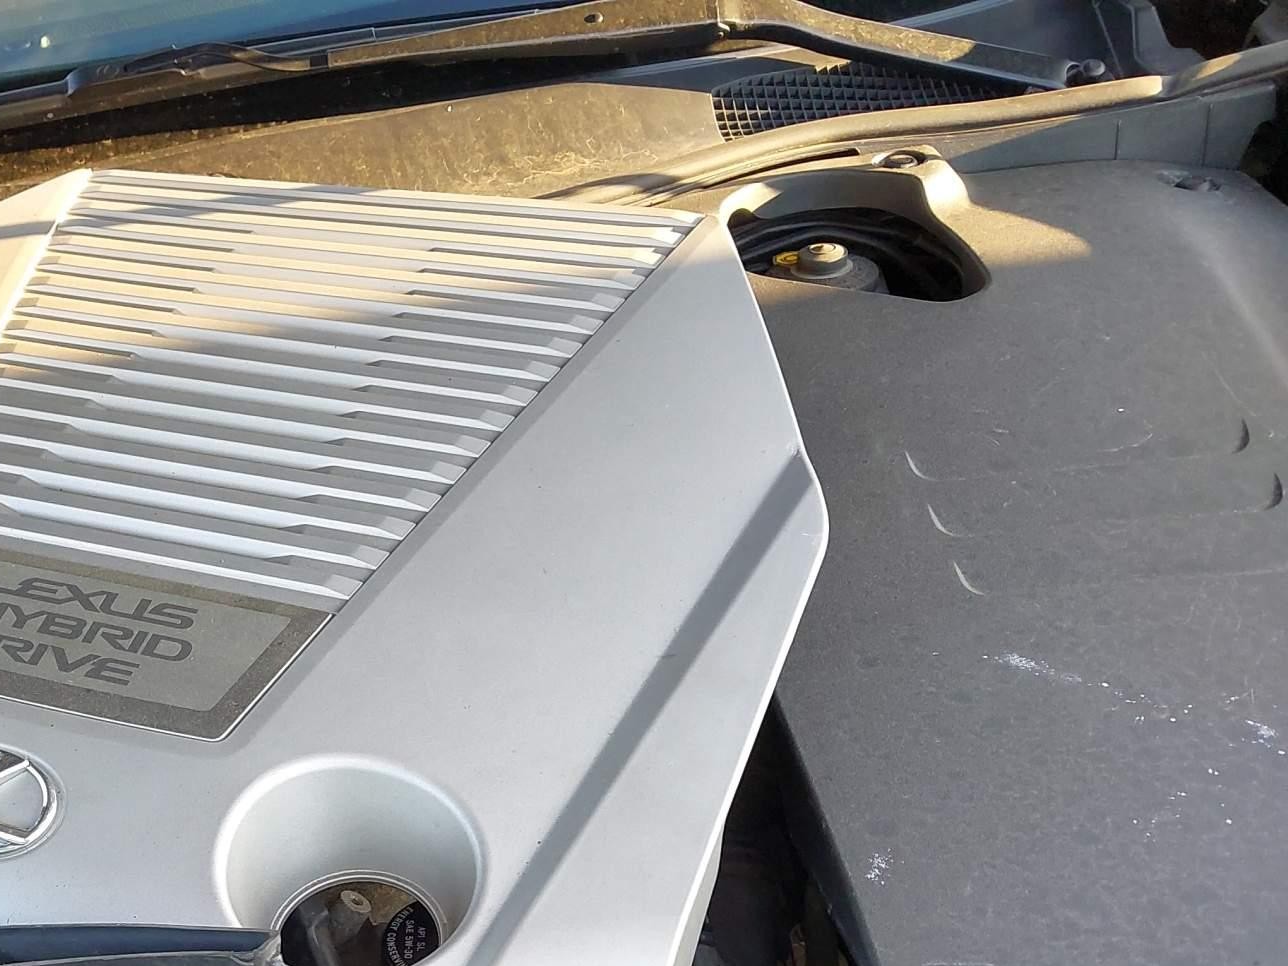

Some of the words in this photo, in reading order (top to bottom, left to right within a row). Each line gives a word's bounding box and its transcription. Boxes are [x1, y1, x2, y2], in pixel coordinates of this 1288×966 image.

[389, 906, 414, 932] ENERGY
[405, 919, 415, 934] SAE
[417, 926, 426, 938] API
[403, 935, 414, 959] 5W-30
